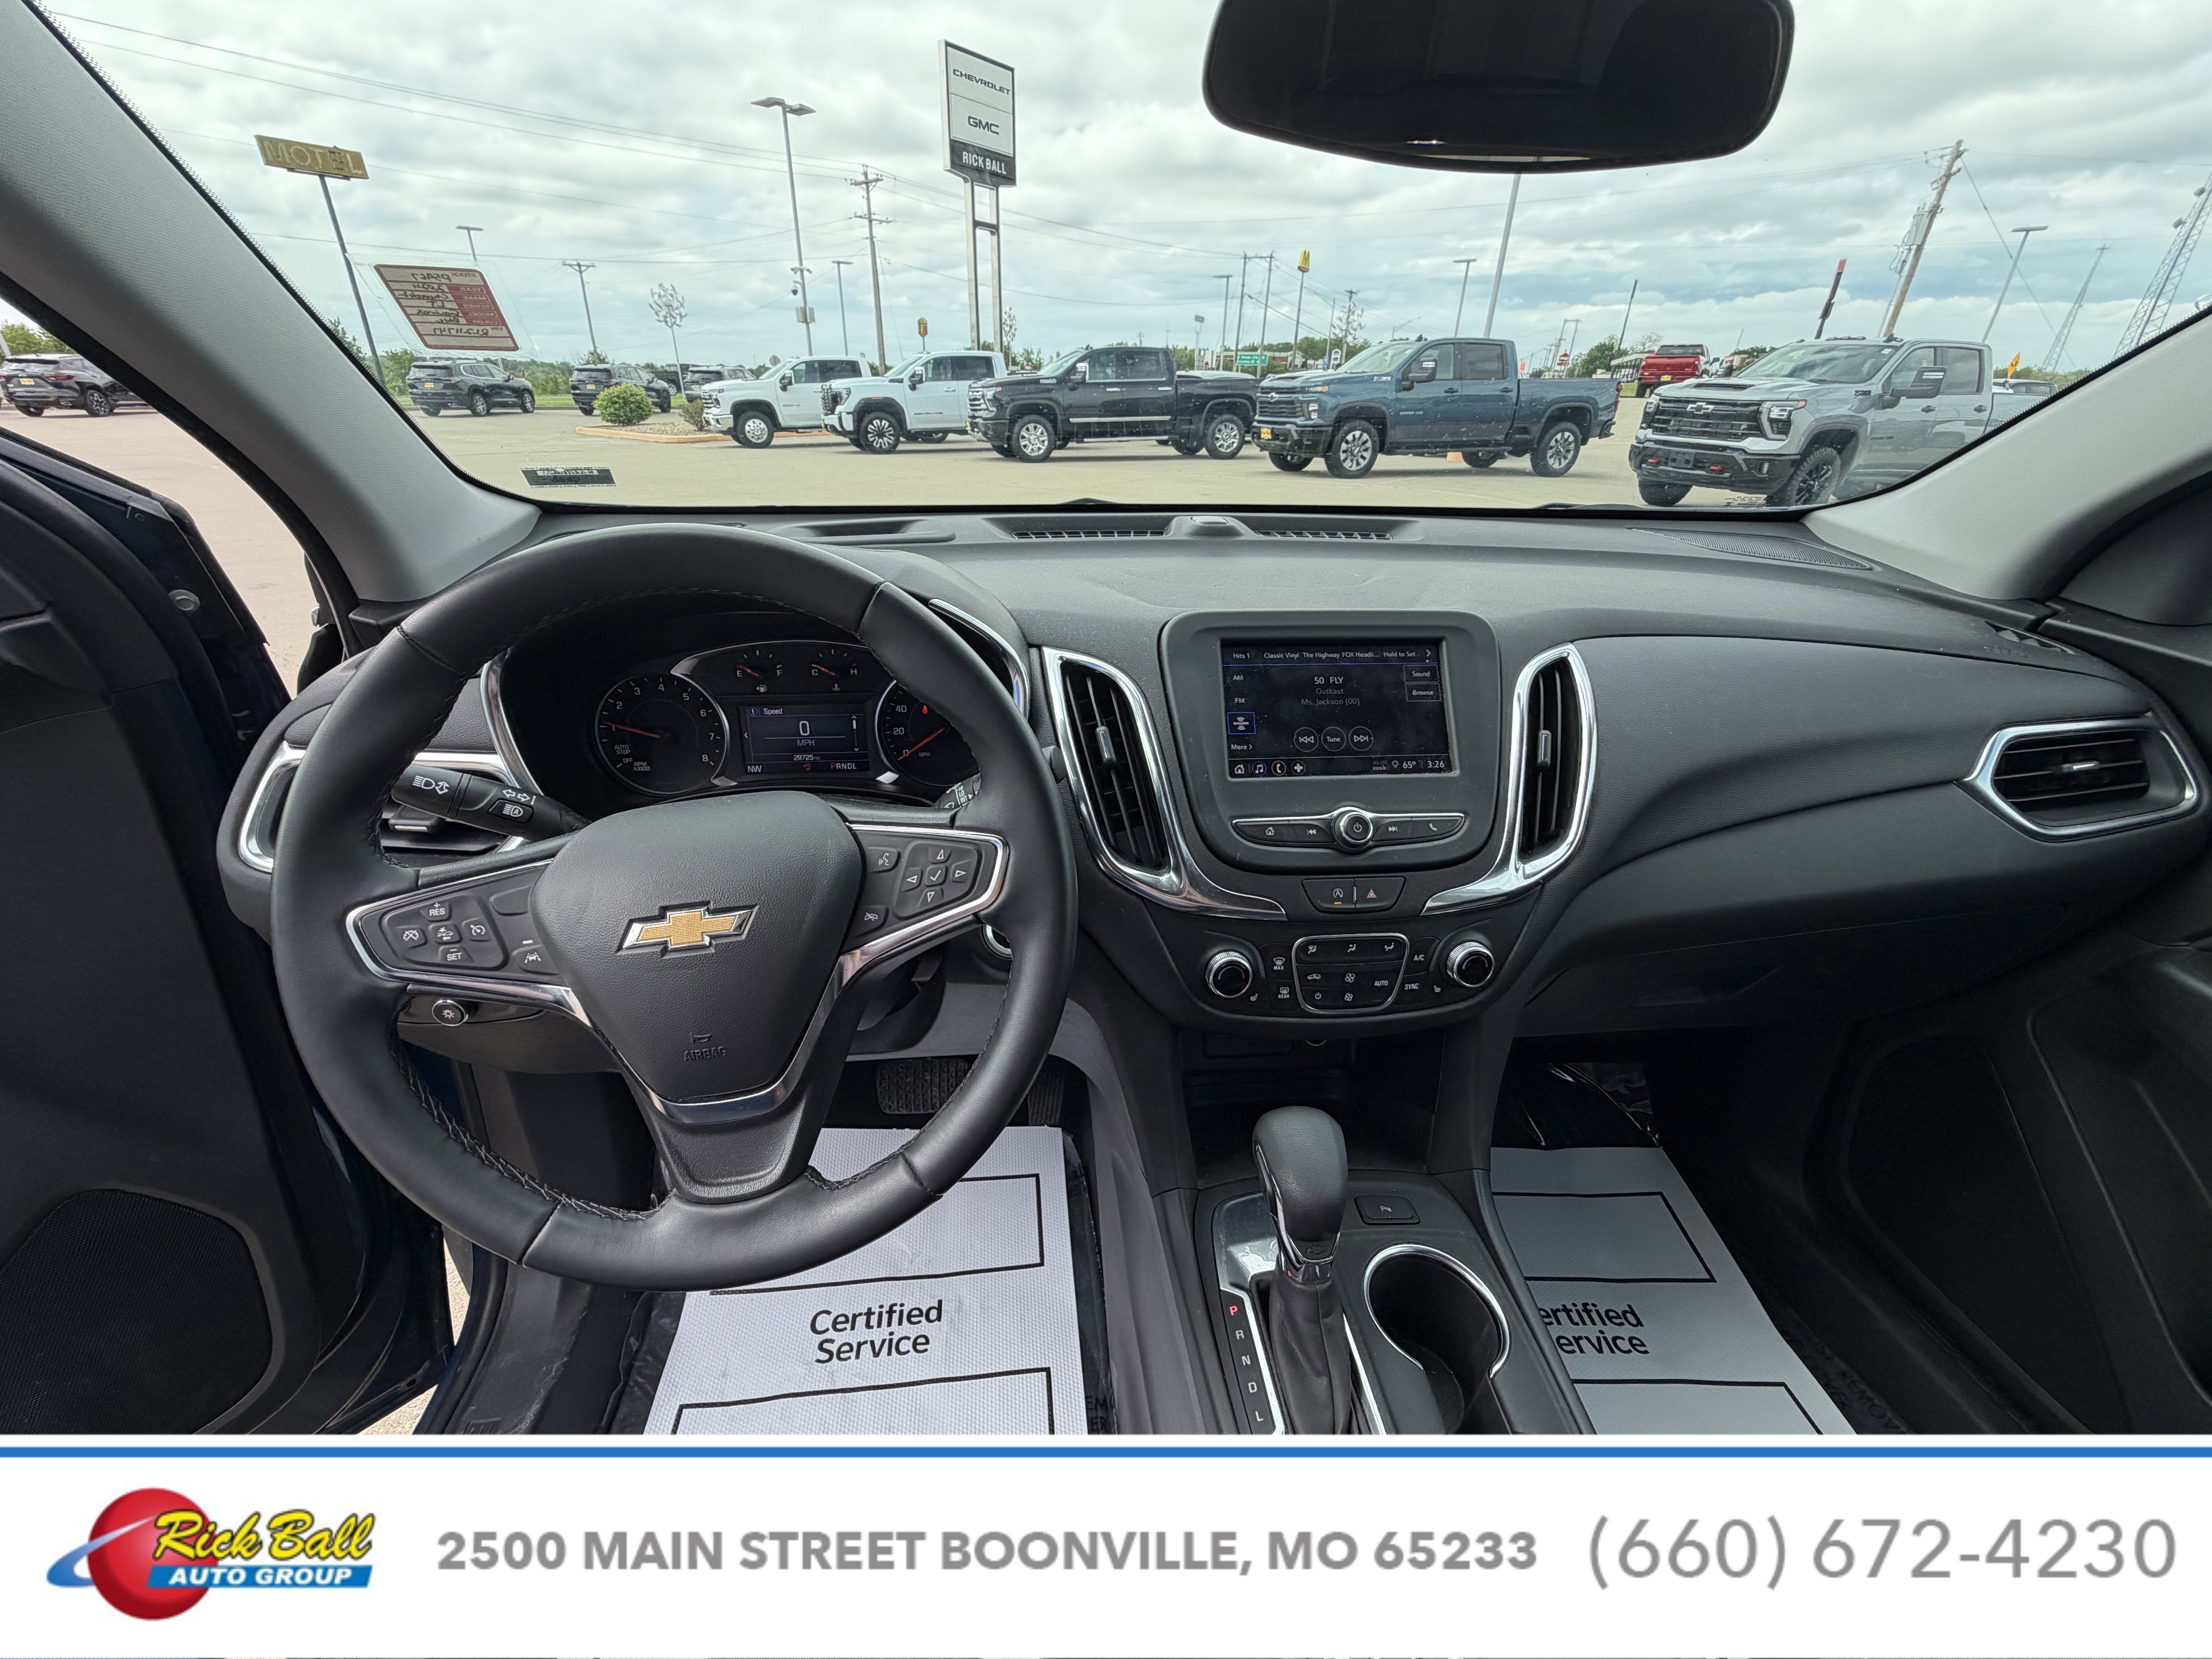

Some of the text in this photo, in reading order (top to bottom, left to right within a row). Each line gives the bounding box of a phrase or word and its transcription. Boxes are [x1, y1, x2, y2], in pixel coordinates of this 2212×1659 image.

[953, 69, 1011, 95] CHEVROLET
[968, 116, 1000, 135] GMC
[264, 139, 364, 174] MOTEL
[962, 151, 1007, 175] RICK BALL
[1345, 698, 1360, 706] (00)
[799, 721, 810, 736] 0
[429, 907, 445, 916] RES
[447, 952, 462, 961] SET
[684, 1046, 726, 1061] AIRBAG
[810, 1299, 943, 1335] Certified
[1229, 1305, 1238, 1316] P
[1538, 1302, 1644, 1328] ertified
[1235, 1330, 1245, 1340] R
[1556, 1329, 1650, 1355] ervice
[814, 1331, 930, 1364] Service
[1242, 1355, 1251, 1366] N
[1248, 1381, 1257, 1394] D
[1255, 1410, 1264, 1422] L
